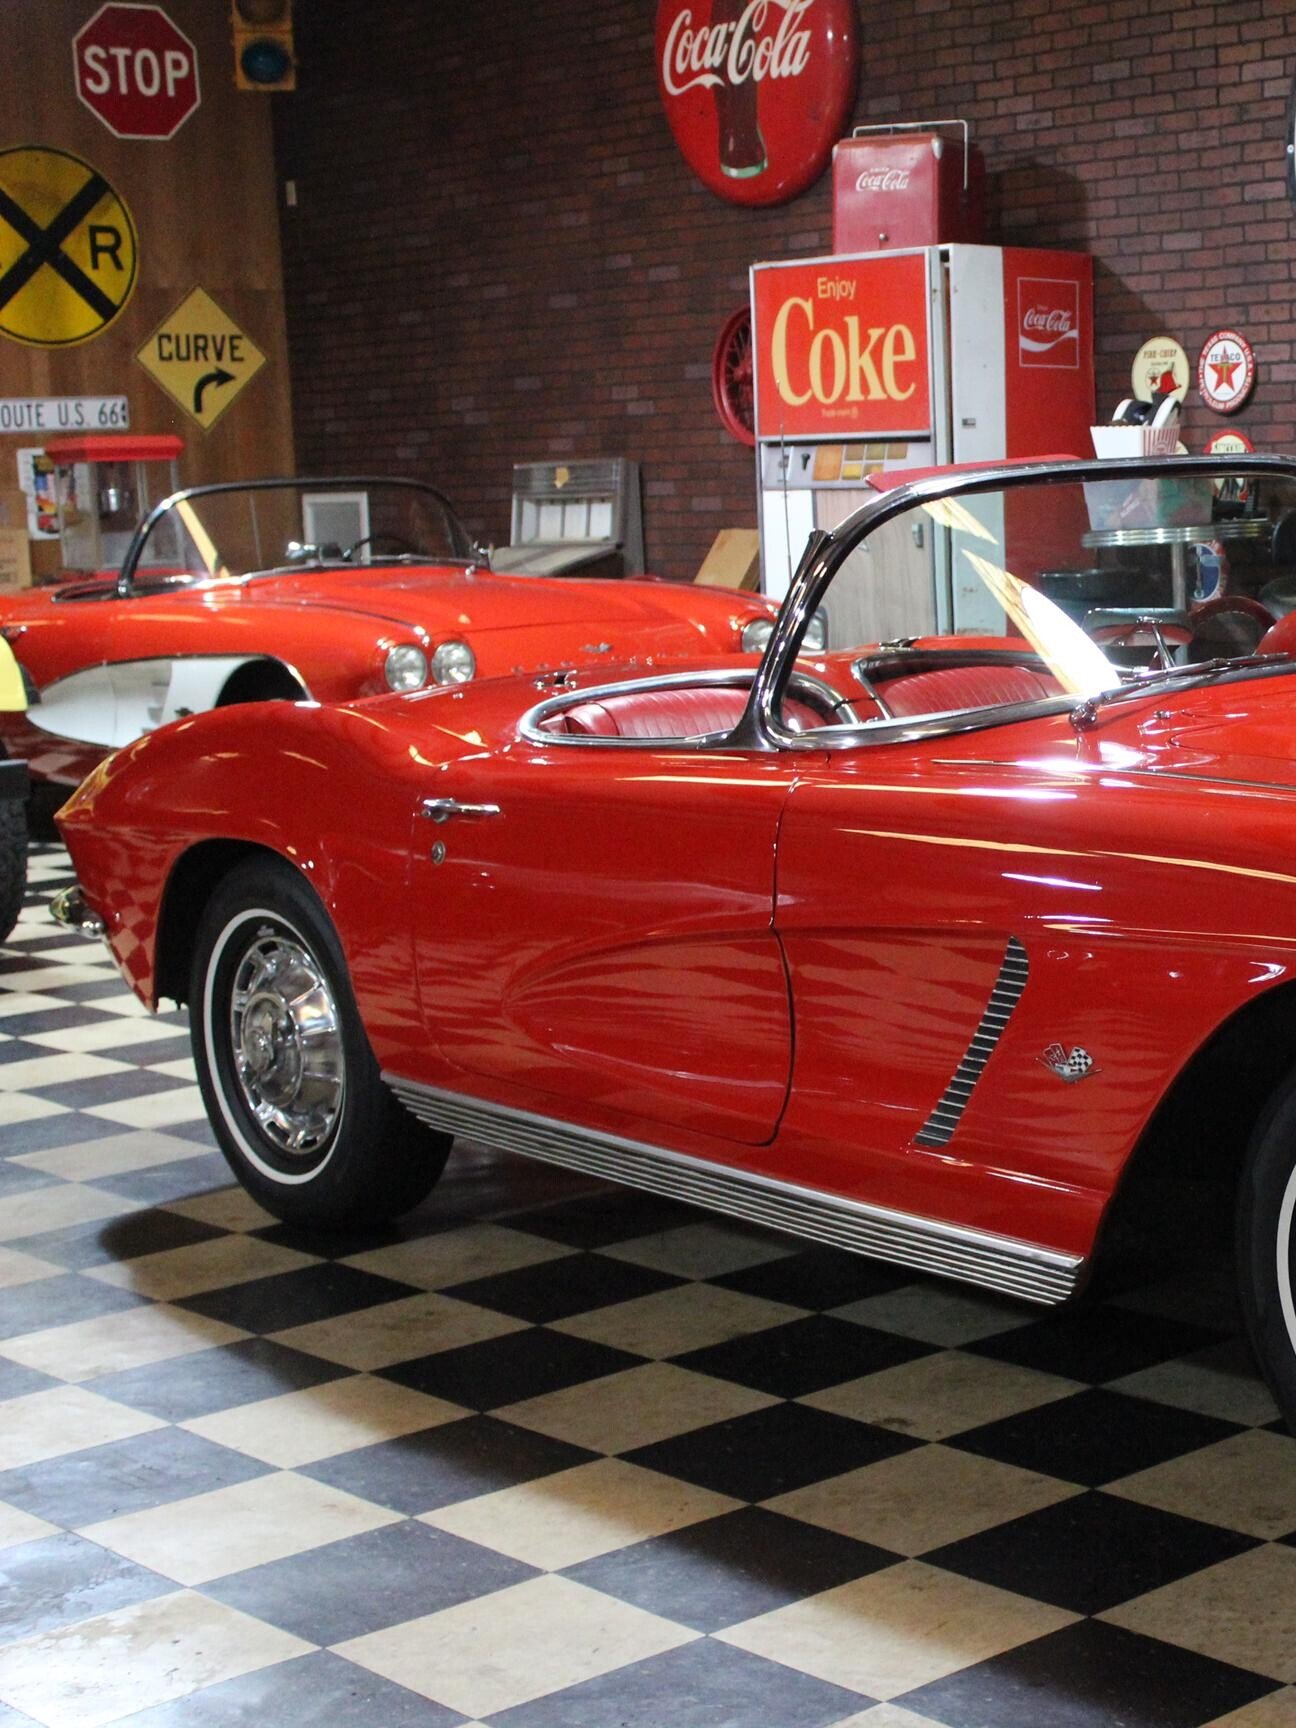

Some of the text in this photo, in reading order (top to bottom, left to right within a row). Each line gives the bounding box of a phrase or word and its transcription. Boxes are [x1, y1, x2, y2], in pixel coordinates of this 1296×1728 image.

[663, 0, 812, 95] Coca-Cola
[84, 45, 189, 97] STOP
[855, 169, 909, 192] Coca-Cola
[89, 225, 124, 271] R
[817, 276, 857, 300] Enjoy
[1023, 308, 1072, 331] Coca-Cola
[157, 333, 244, 362] CURVE
[771, 296, 917, 407] Coke
[57, 403, 91, 426] U.S.
[98, 402, 119, 425] 66
